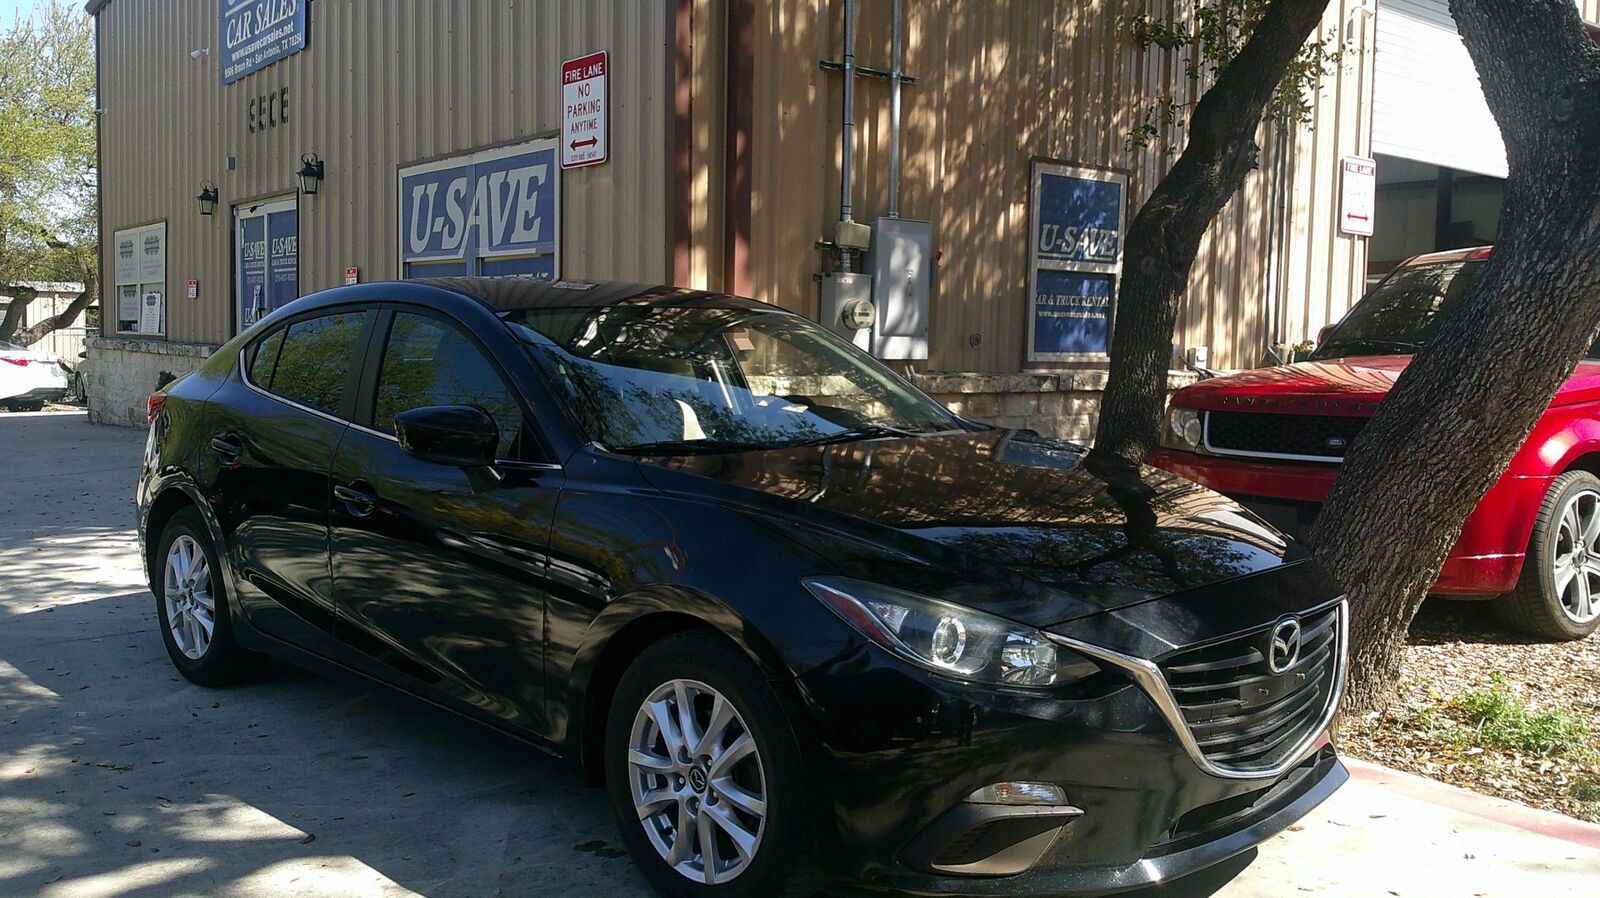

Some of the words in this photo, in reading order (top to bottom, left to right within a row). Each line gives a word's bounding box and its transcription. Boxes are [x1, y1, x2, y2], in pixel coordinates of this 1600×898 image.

[227, 10, 252, 49] CAR
[281, 38, 289, 51] TX
[564, 68, 581, 83] FIRE
[583, 62, 603, 78] LANE
[578, 83, 590, 98] NO
[567, 99, 601, 118] PARKING
[570, 118, 598, 134] ANYTIME
[410, 164, 548, 254] U-SAVE
[1039, 224, 1118, 256] U-SAVE
[1036, 294, 1047, 305] AR
[1056, 295, 1080, 306] TRUCK
